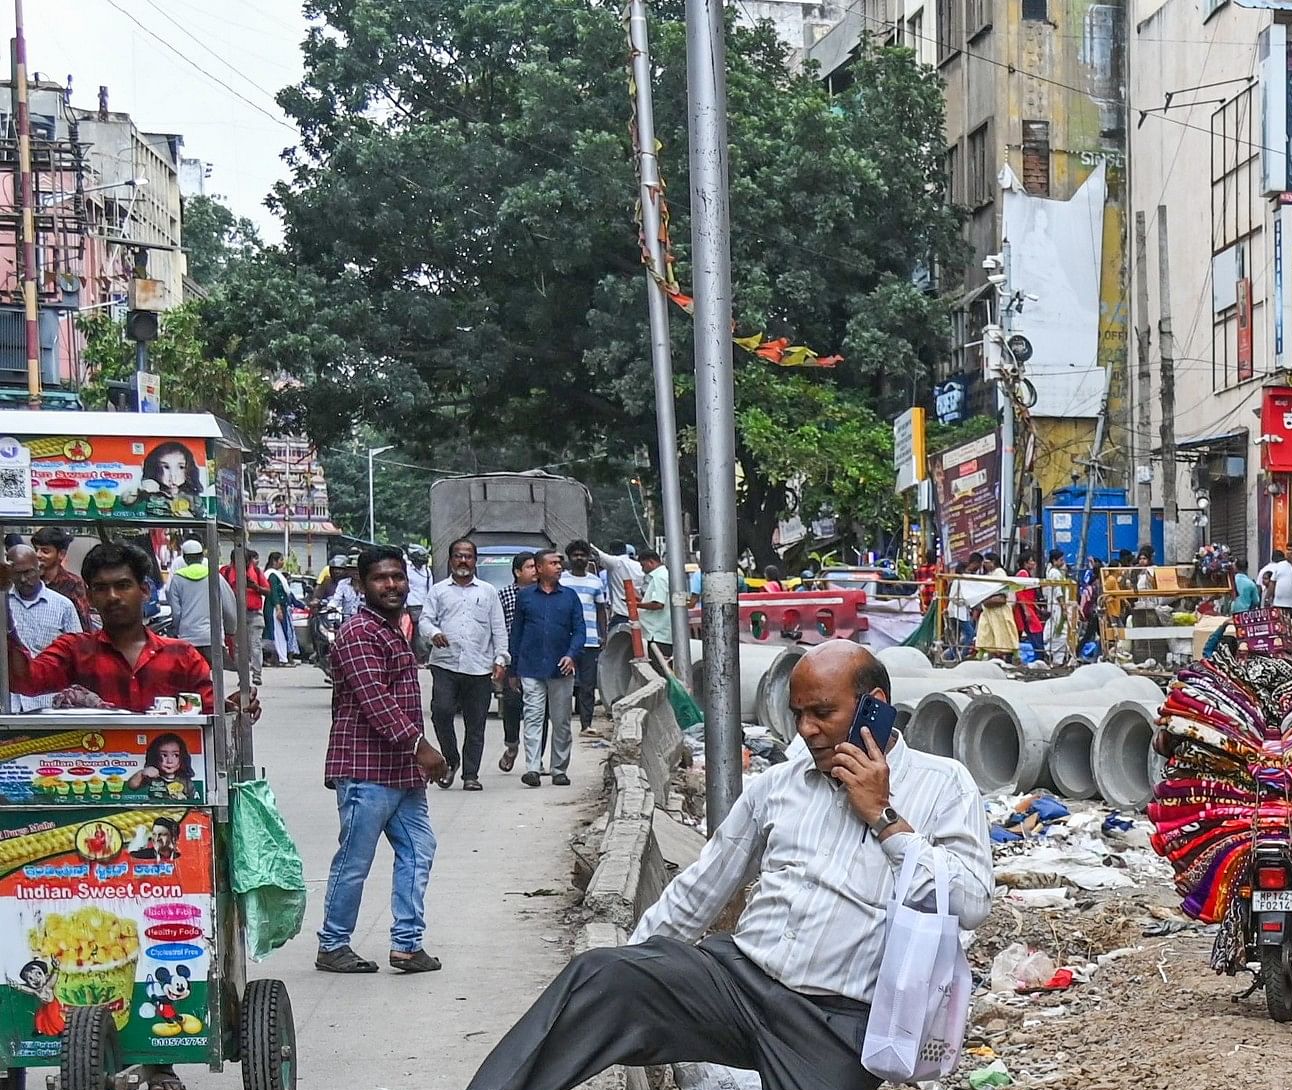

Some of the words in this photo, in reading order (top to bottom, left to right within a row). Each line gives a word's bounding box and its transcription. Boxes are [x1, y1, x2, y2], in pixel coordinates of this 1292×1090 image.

[1104, 330, 1128, 341] OFFI
[17, 884, 72, 899] Indian
[78, 883, 135, 898] Sweet
[140, 882, 182, 898] Corn
